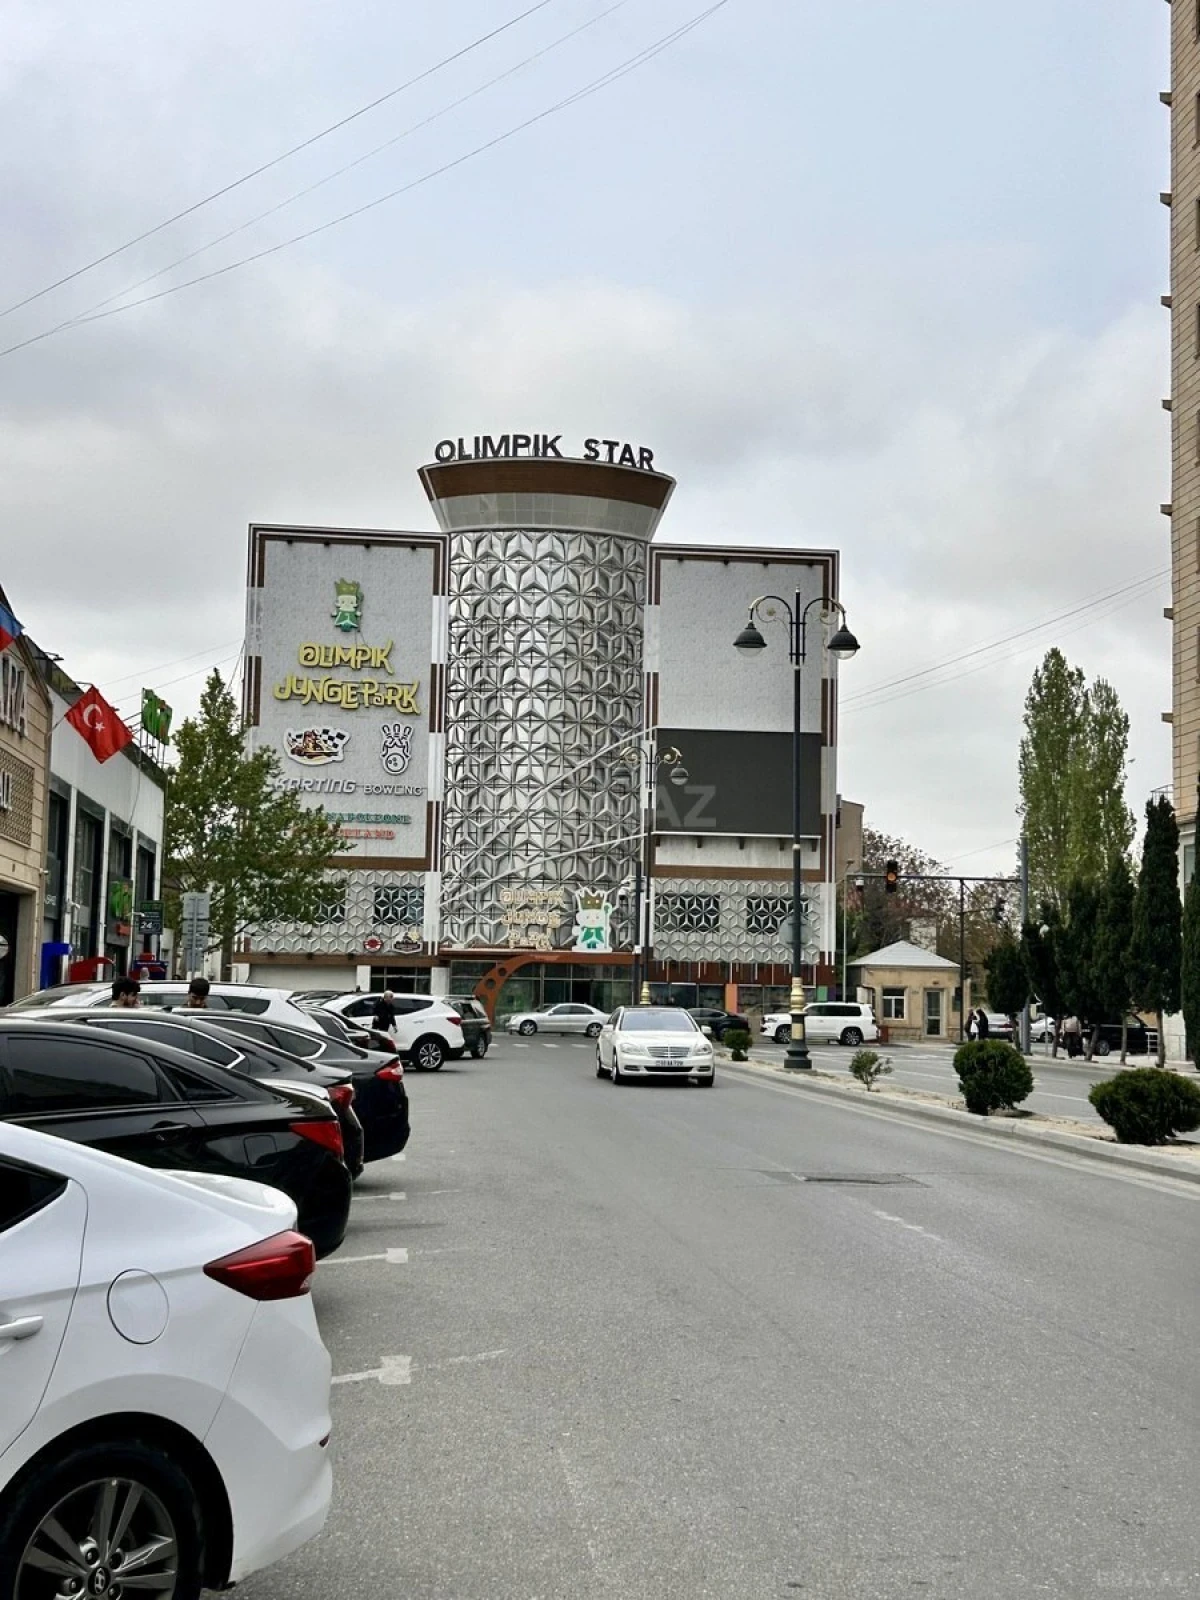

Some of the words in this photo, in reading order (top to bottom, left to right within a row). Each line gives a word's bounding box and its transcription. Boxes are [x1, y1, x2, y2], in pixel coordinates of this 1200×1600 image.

[435, 434, 564, 463] OLIMPIK
[583, 438, 654, 471] STAR
[298, 639, 394, 675] OLIMPIK
[273, 675, 361, 710] JUNGLE
[273, 777, 357, 794] KARTING
